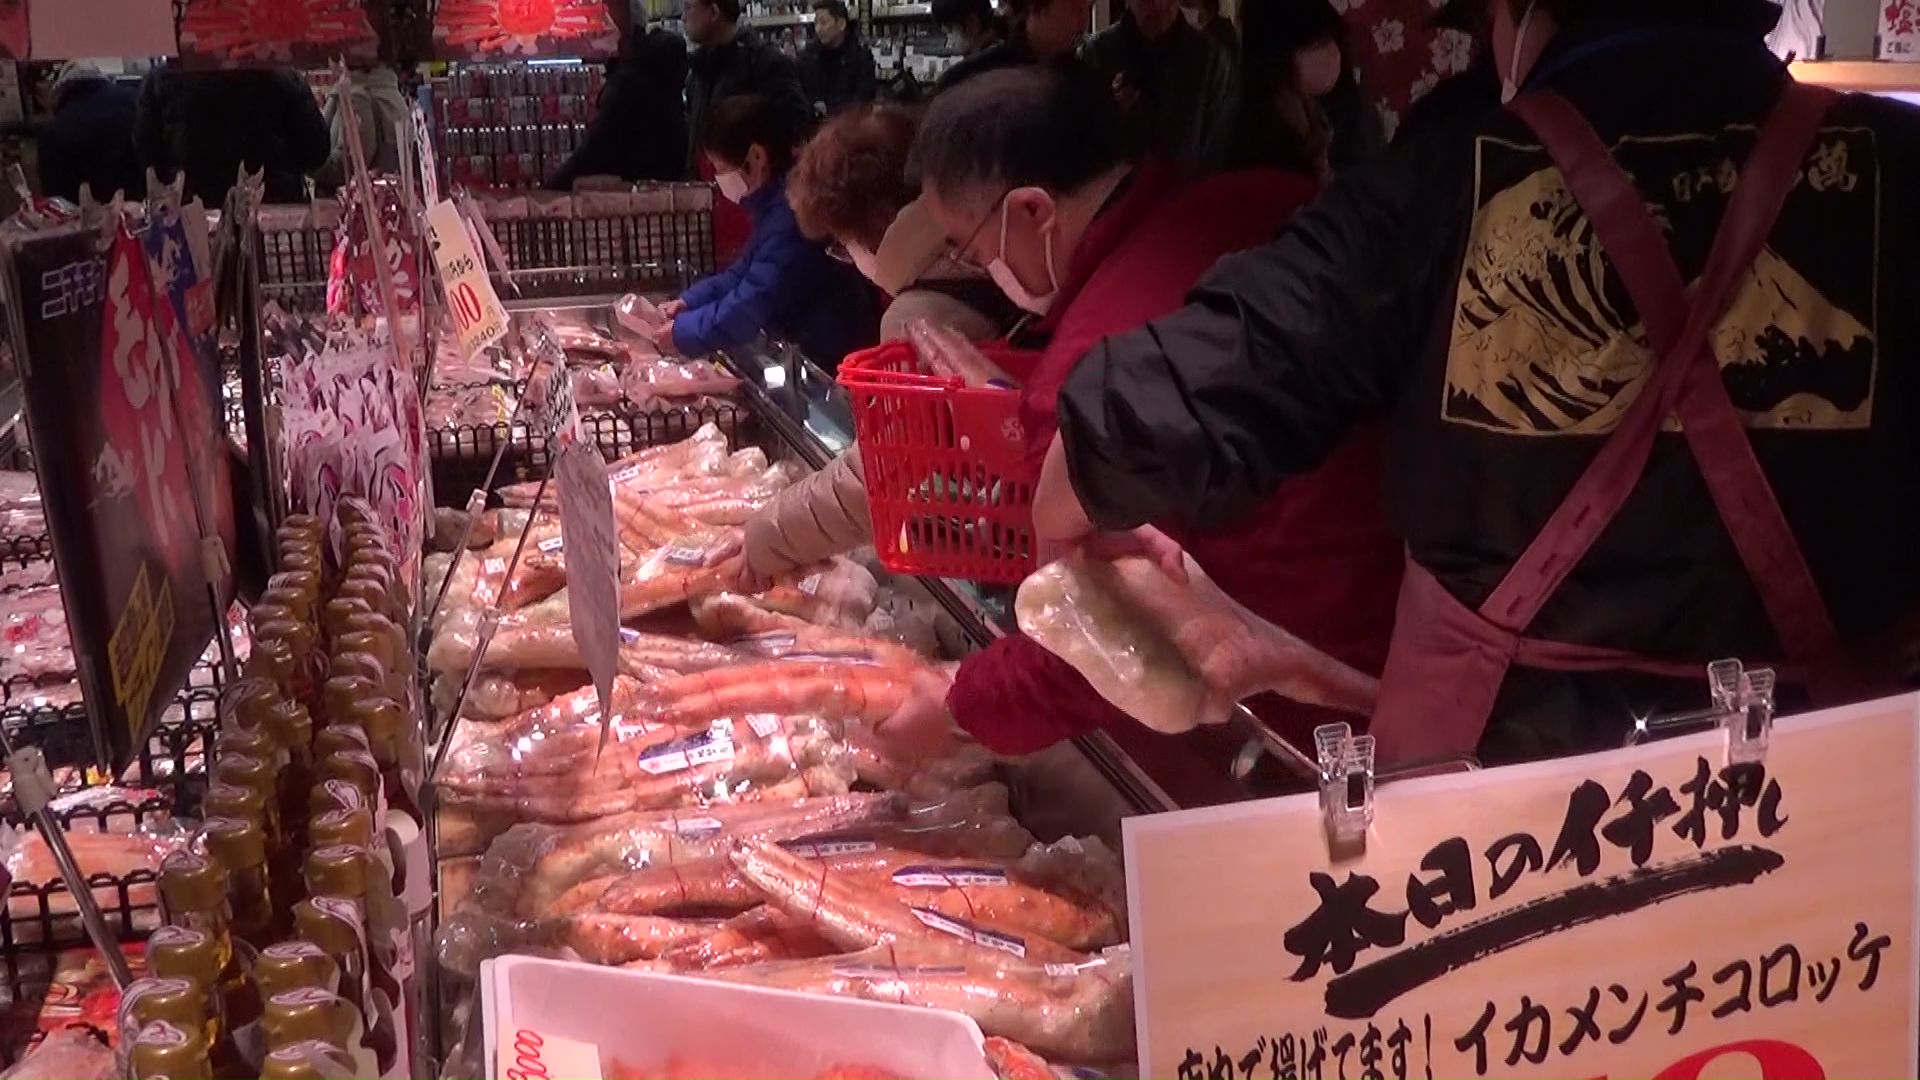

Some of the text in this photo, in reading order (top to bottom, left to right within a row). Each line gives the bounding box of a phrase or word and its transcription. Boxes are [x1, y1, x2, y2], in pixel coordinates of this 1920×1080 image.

[1284, 755, 1790, 982] 本日のイチ押し
[1455, 921, 1891, 1075] イカメンチコロッケ
